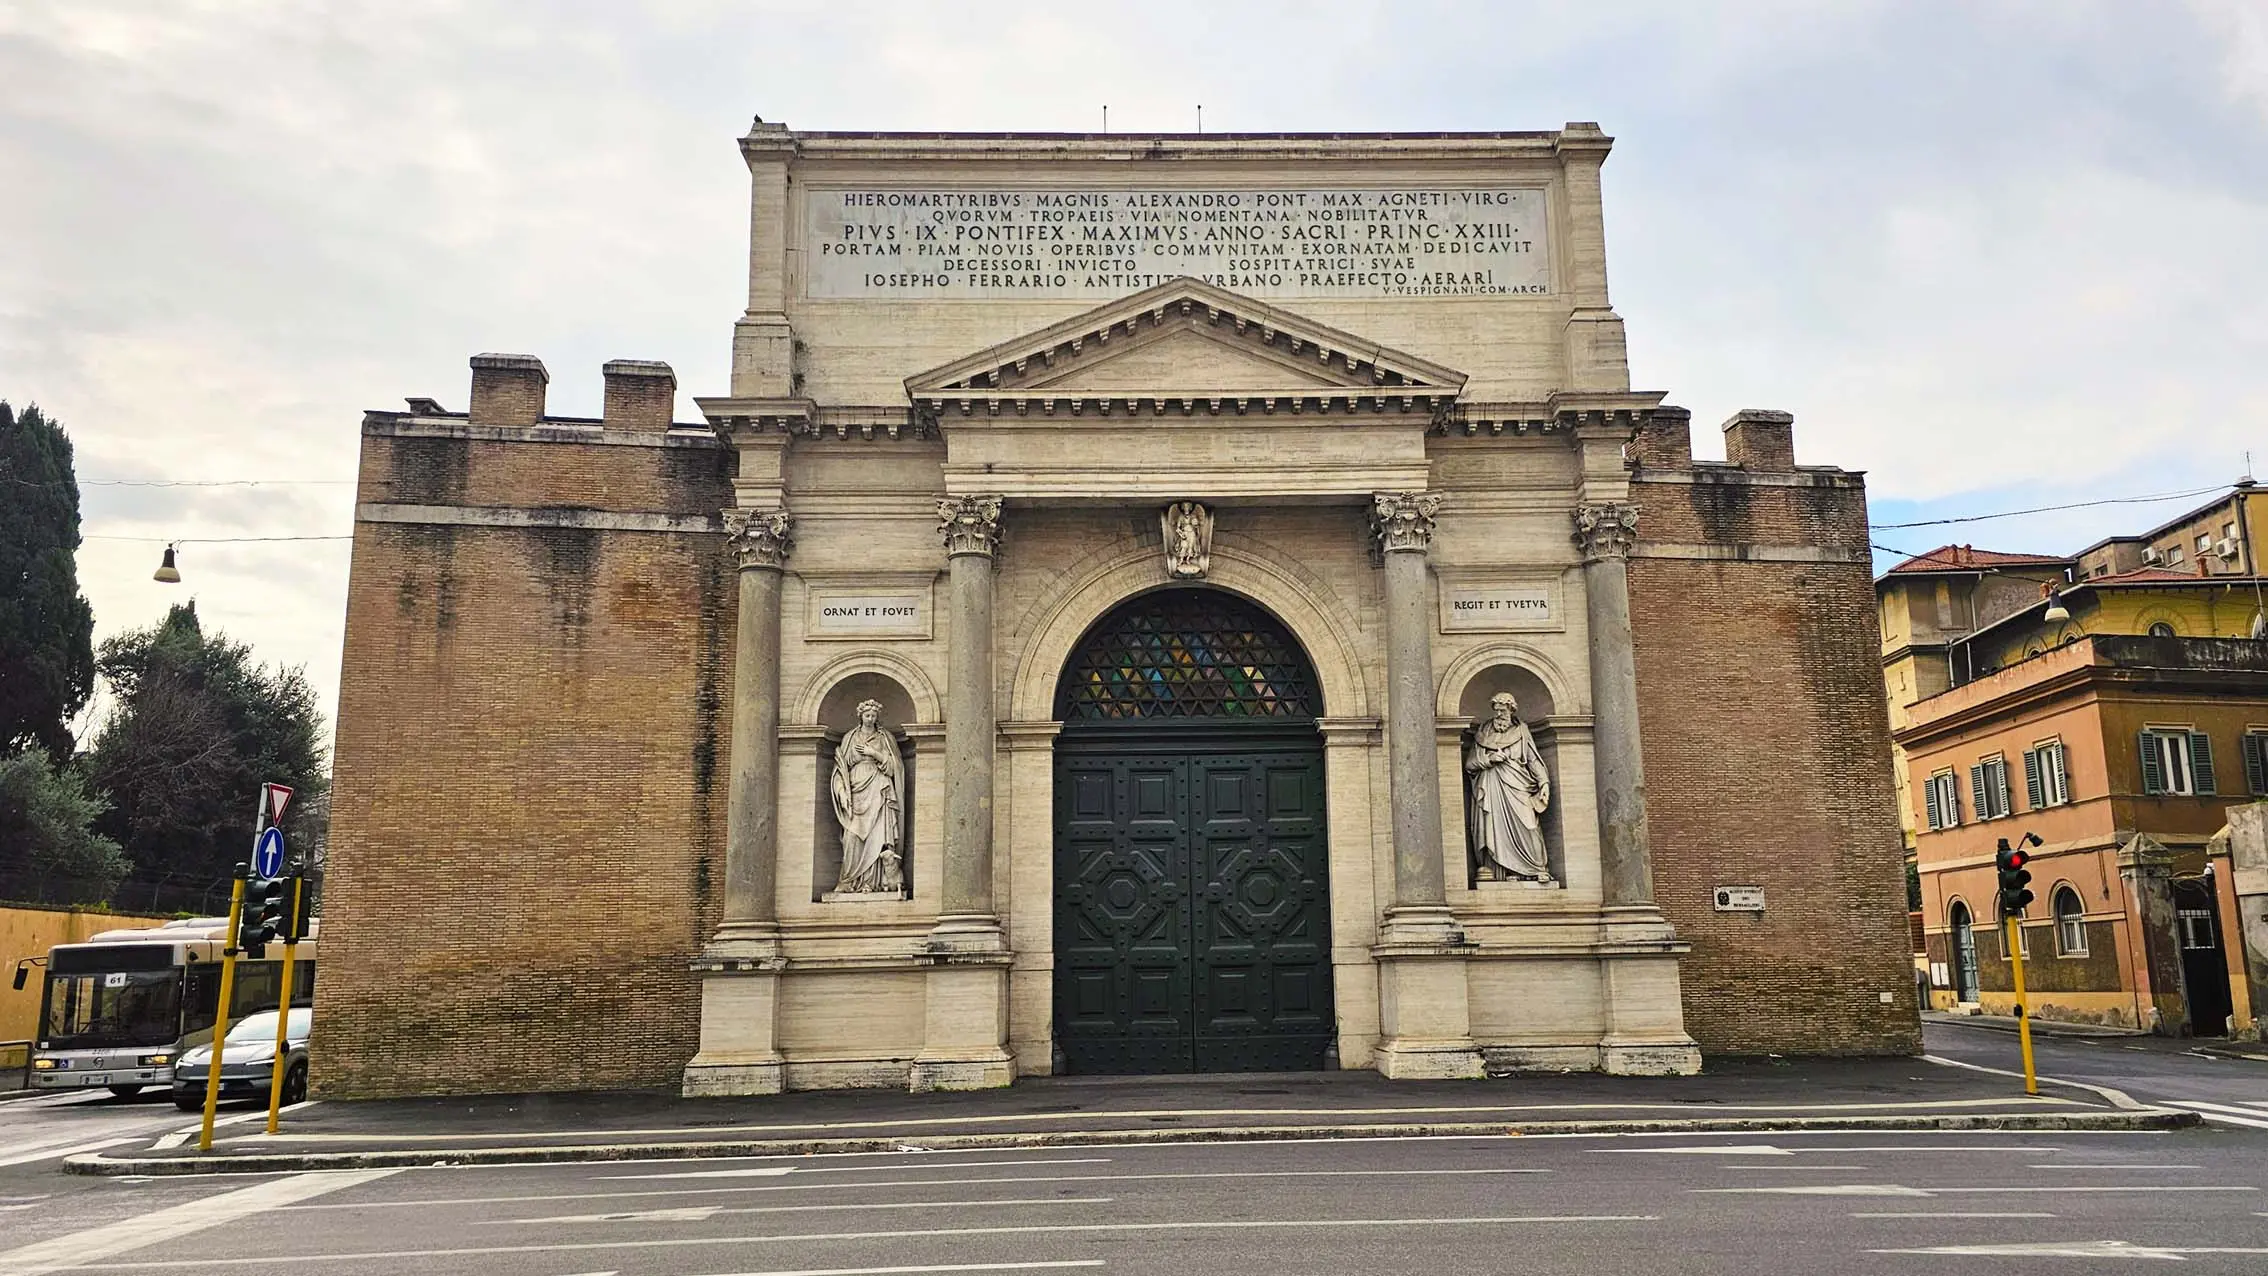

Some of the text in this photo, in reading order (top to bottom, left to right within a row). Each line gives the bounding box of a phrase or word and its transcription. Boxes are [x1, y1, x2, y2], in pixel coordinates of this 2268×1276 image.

[845, 194, 1021, 206] HIEROMARTYRIBVS
[1037, 195, 1109, 207] MAGNIS
[1127, 195, 1240, 207] ALEXANDRO
[1257, 194, 1306, 207] PONT
[1323, 194, 1362, 206] MAX
[1379, 193, 1447, 205] AGNETI
[933, 210, 1428, 224] QVORVM TROPAEIS VIA NOMENTANA NOBILITATVR
[845, 226, 895, 239] PIVS
[916, 226, 937, 239] IX
[956, 226, 1063, 240] PONTIFEX
[1083, 226, 1188, 240] MAXIMVS
[1205, 226, 1264, 240] ANNO
[1282, 225, 1345, 239] SACRI
[1368, 225, 1439, 239] PRINC
[823, 242, 1532, 256] PORTAM PIAM NOVIS OPERIBVS COMMVNITAM EXORNATAM DEDICAVIT
[944, 258, 1415, 271] DECESSORI INVICTO SOSPITATRICI SVAE
[865, 270, 1492, 287] IOSEPHO FERRARIO ANTISTIT VRBANO PRAEFECTO AERARI
[823, 606, 916, 617] ORNAT ET FOVET
[1453, 599, 1548, 610] REGIT ET TVETVR
